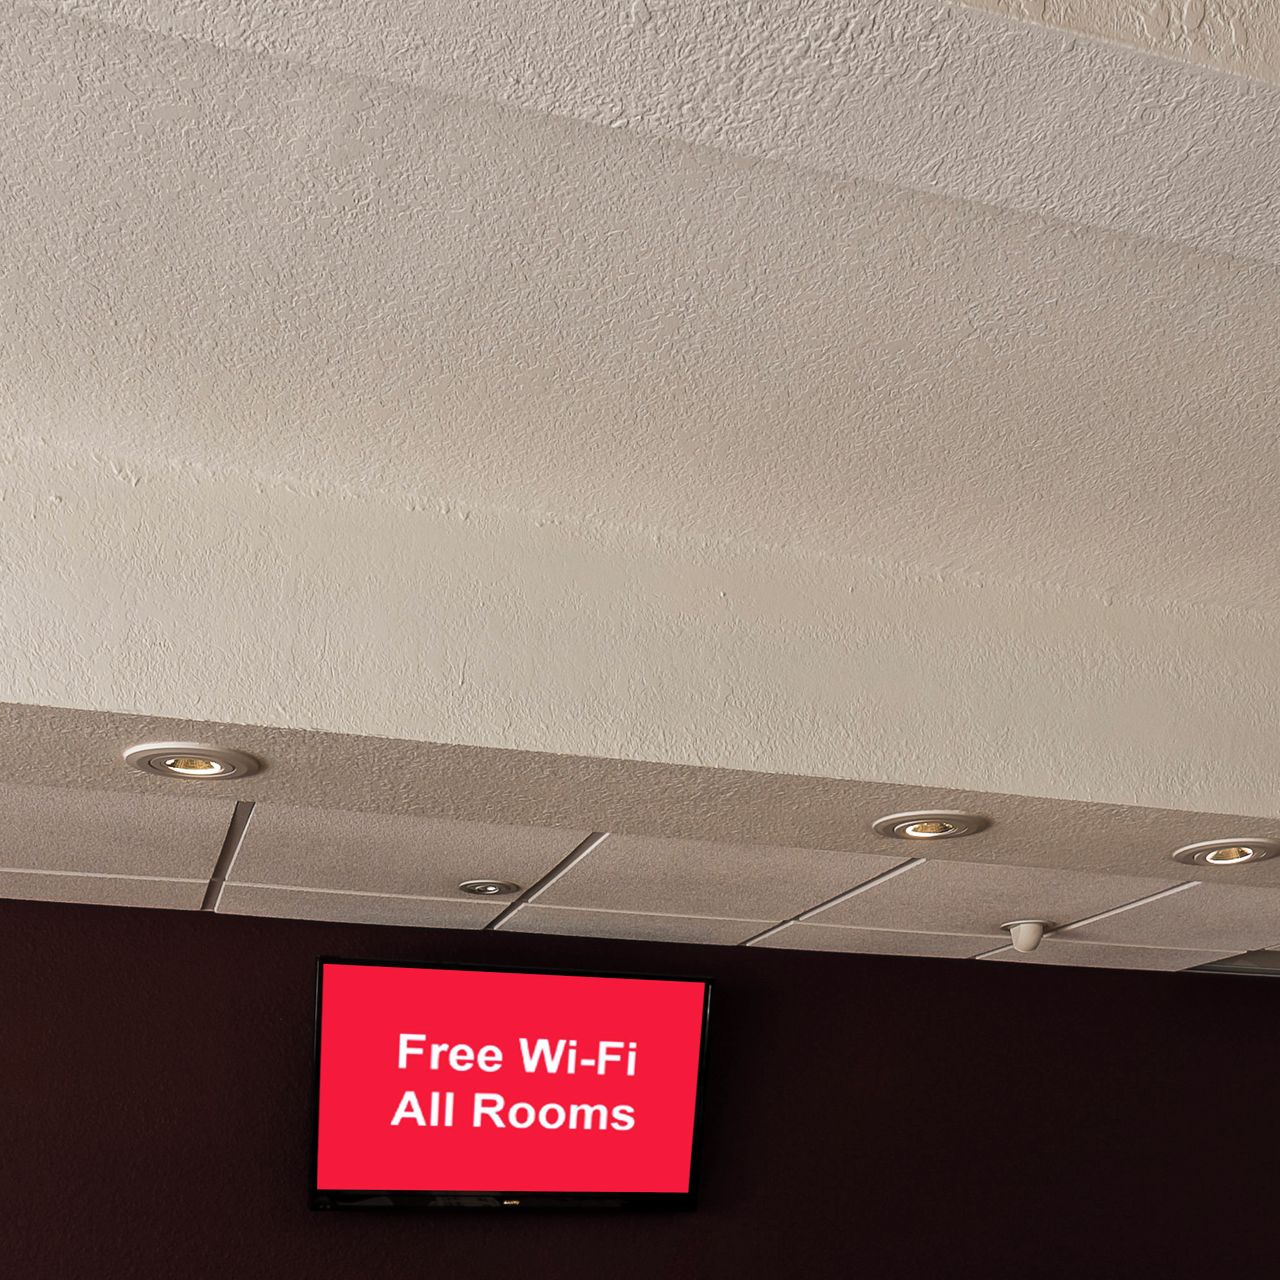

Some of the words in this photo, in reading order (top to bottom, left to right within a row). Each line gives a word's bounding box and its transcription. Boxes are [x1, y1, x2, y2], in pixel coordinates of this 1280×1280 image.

[397, 1033, 504, 1073] Free
[519, 1037, 637, 1076] Wi-Fi
[390, 1090, 455, 1127] All
[472, 1092, 636, 1131] Rooms
